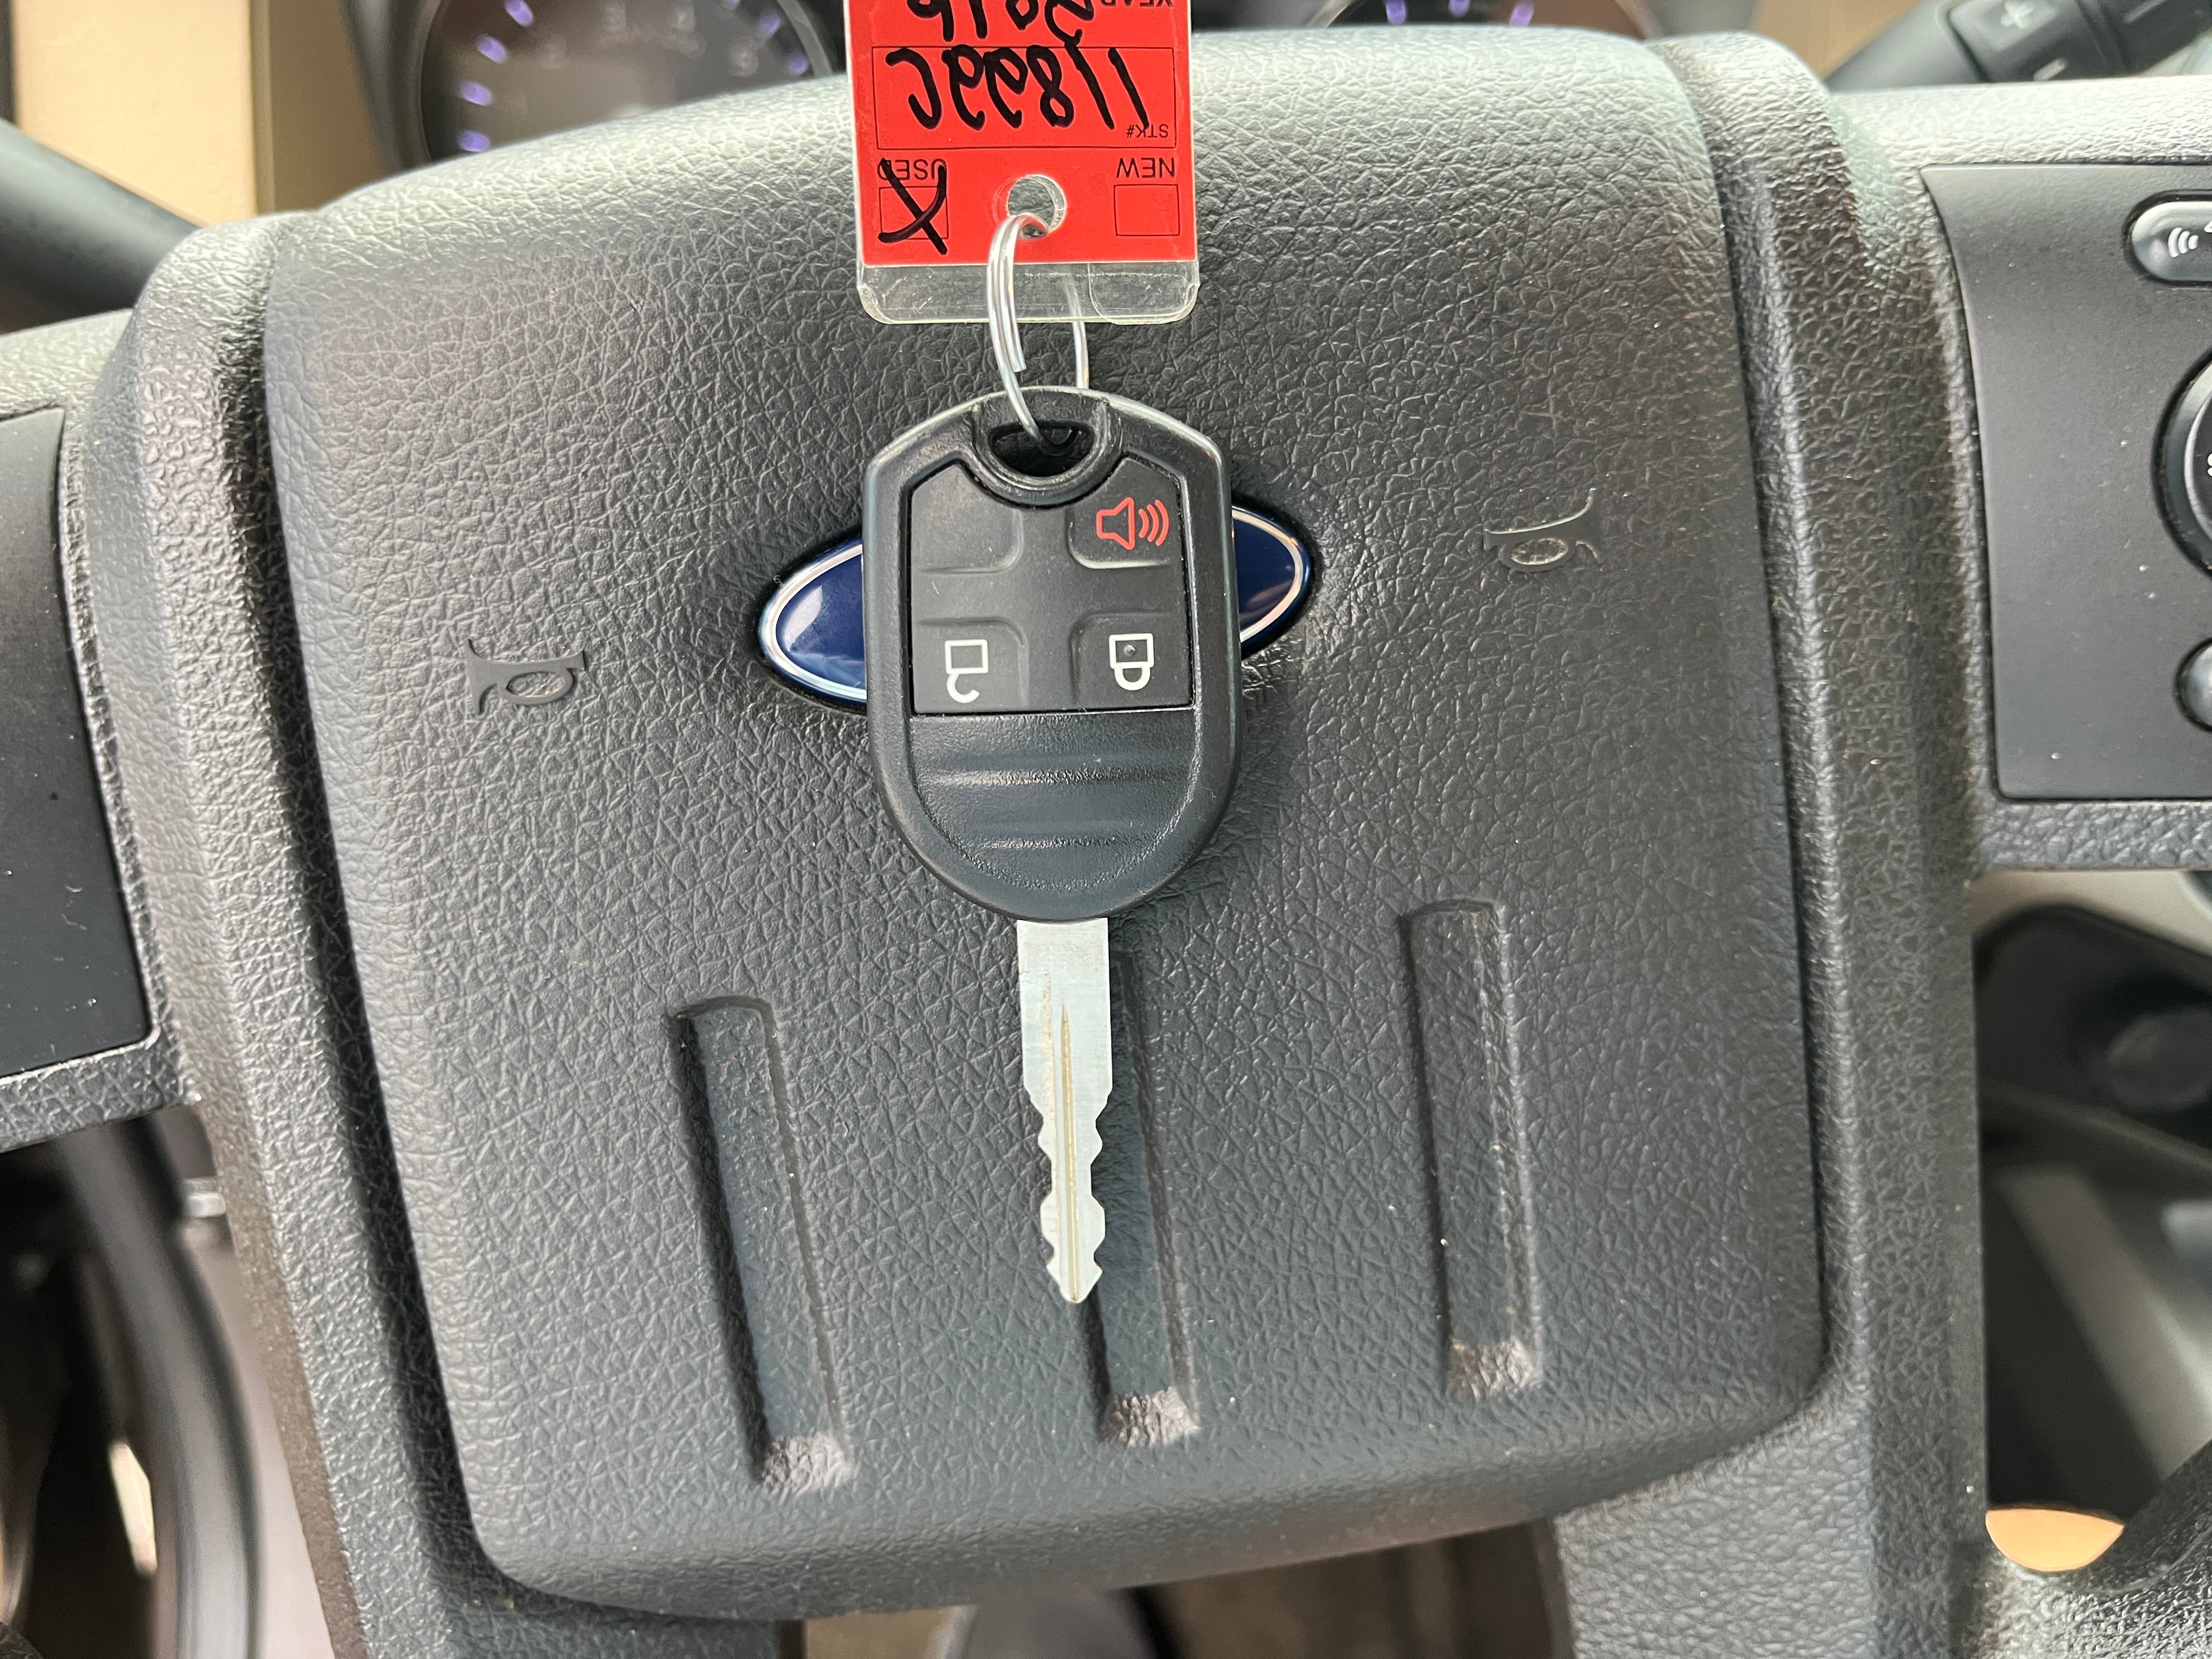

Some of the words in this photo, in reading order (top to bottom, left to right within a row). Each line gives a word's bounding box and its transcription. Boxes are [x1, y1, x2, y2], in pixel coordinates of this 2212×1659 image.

[1126, 124, 1169, 138] STK#
[878, 158, 947, 180] USED
[1116, 157, 1175, 179] NEW
